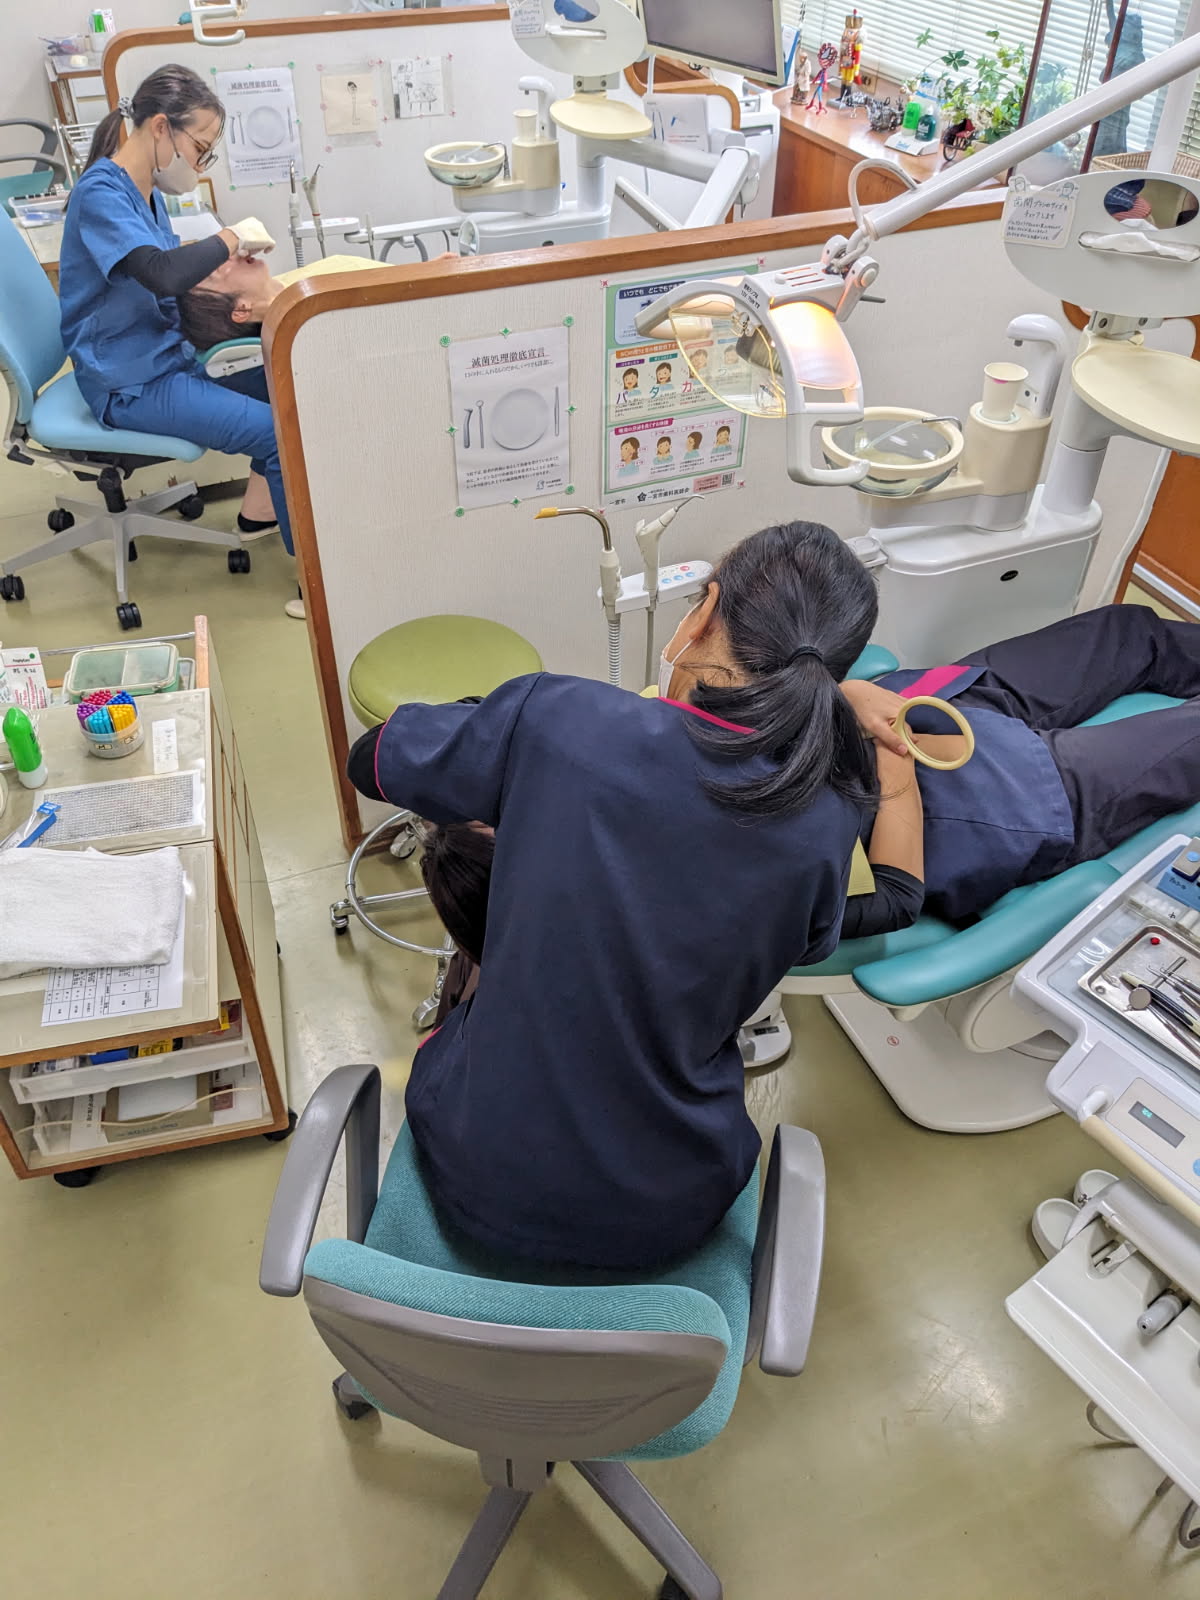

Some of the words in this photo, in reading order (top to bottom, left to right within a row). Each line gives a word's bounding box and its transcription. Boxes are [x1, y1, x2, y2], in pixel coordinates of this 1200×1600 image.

[623, 288, 645, 298] いつでも
[472, 347, 545, 368] 滅菌処理徹底宣言
[650, 386, 660, 399] タ
[682, 381, 692, 393] カ
[616, 391, 628, 405] パ
[648, 487, 690, 499] 一宮市歯科医師会
